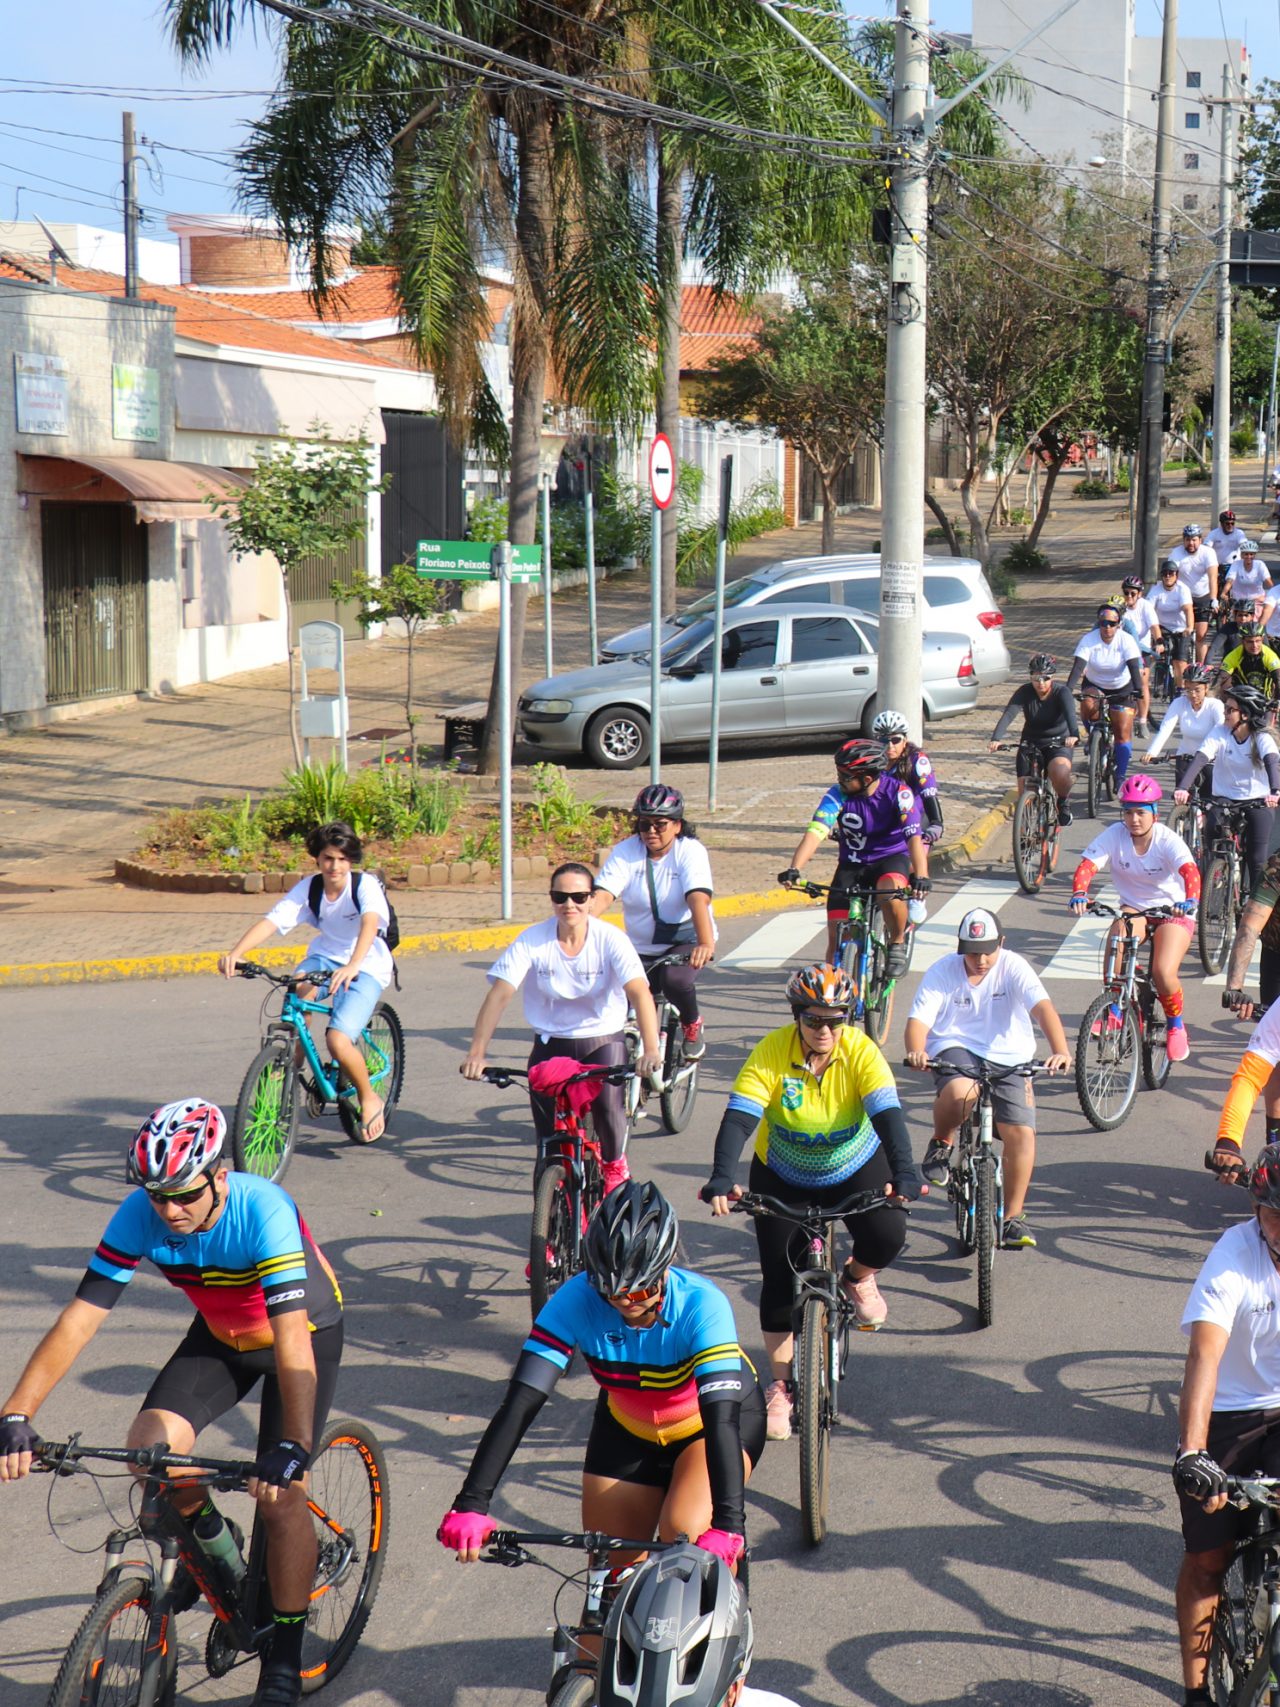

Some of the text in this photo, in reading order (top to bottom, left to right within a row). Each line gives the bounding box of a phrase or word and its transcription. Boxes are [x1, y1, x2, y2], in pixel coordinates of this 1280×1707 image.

[419, 543, 440, 552] Rua
[419, 558, 491, 570] Floriano Peixoto
